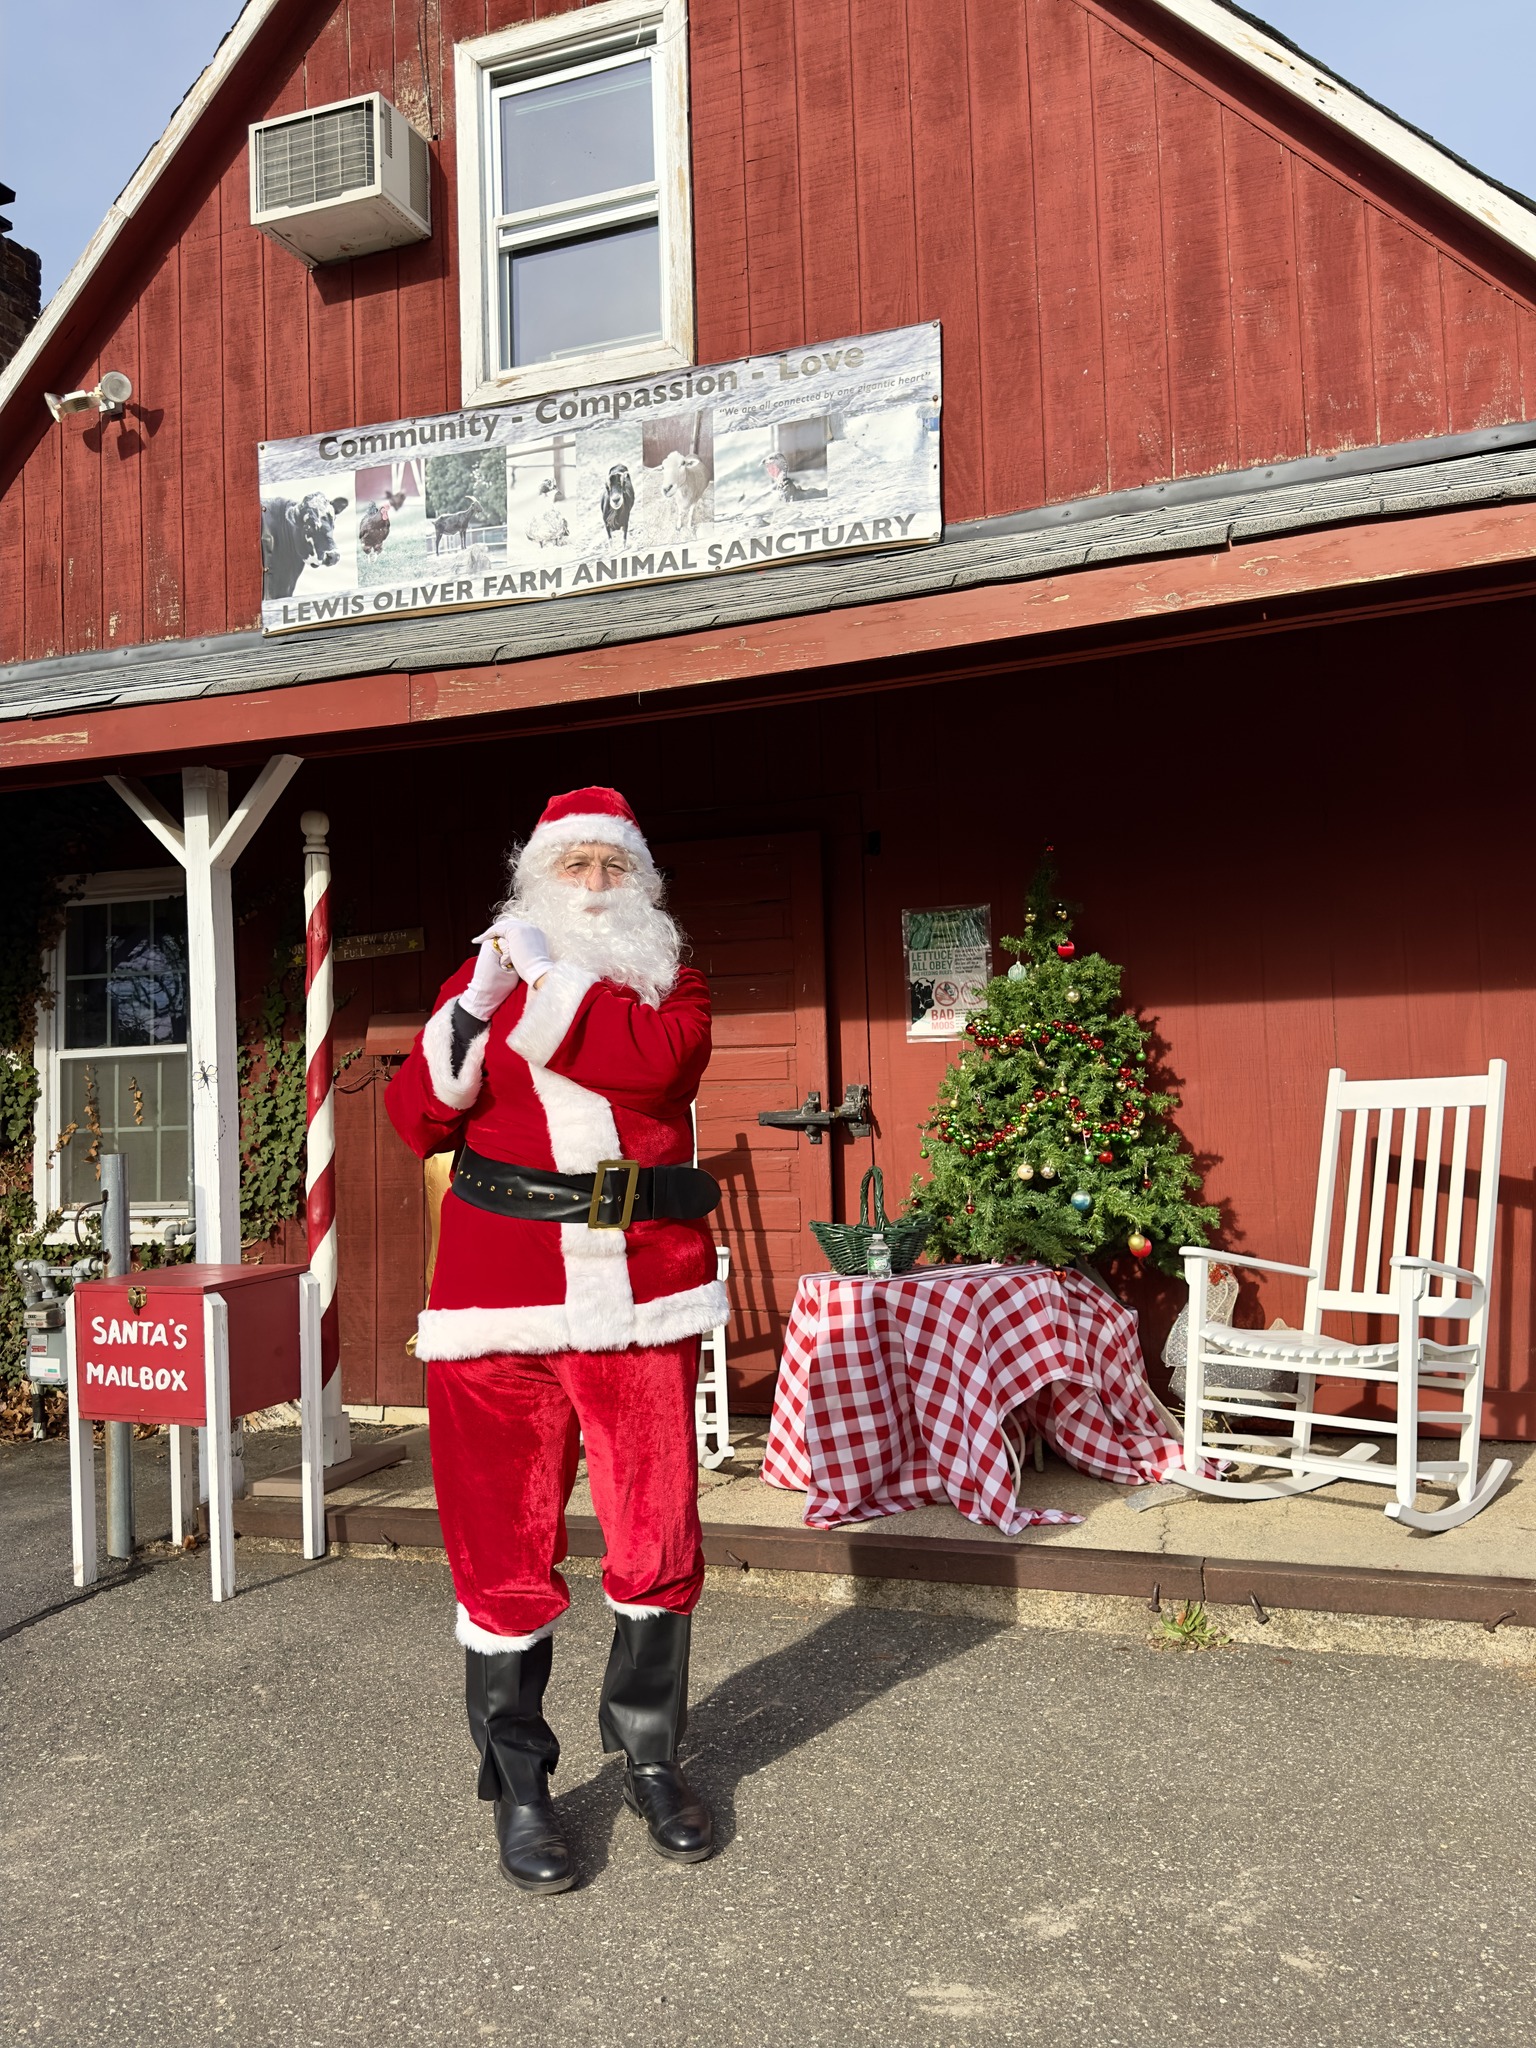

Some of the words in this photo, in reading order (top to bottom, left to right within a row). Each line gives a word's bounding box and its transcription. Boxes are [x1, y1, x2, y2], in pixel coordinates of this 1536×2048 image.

[318, 413, 500, 461] Community
[535, 371, 738, 425] Compassion
[779, 347, 865, 382] Love
[741, 405, 757, 414] are
[759, 400, 771, 411] all
[773, 392, 821, 408] connected
[824, 390, 835, 402] by
[837, 387, 855, 397] one
[857, 379, 896, 395] gigantic
[282, 595, 365, 624] LEWIS
[373, 580, 474, 610] OLIVER
[483, 567, 563, 597] FARM
[572, 548, 698, 587] ANIMAL
[707, 513, 916, 567] SANCTUARY
[356, 936, 378, 947] NEW
[343, 948, 366, 959] FULL
[911, 950, 953, 962] LETTUCE
[912, 962, 928, 972] ALL
[929, 960, 953, 971] OBEY
[931, 1008, 955, 1021] BAD
[91, 1316, 188, 1350] SANTA'S
[86, 1361, 188, 1392] MAILBOX
